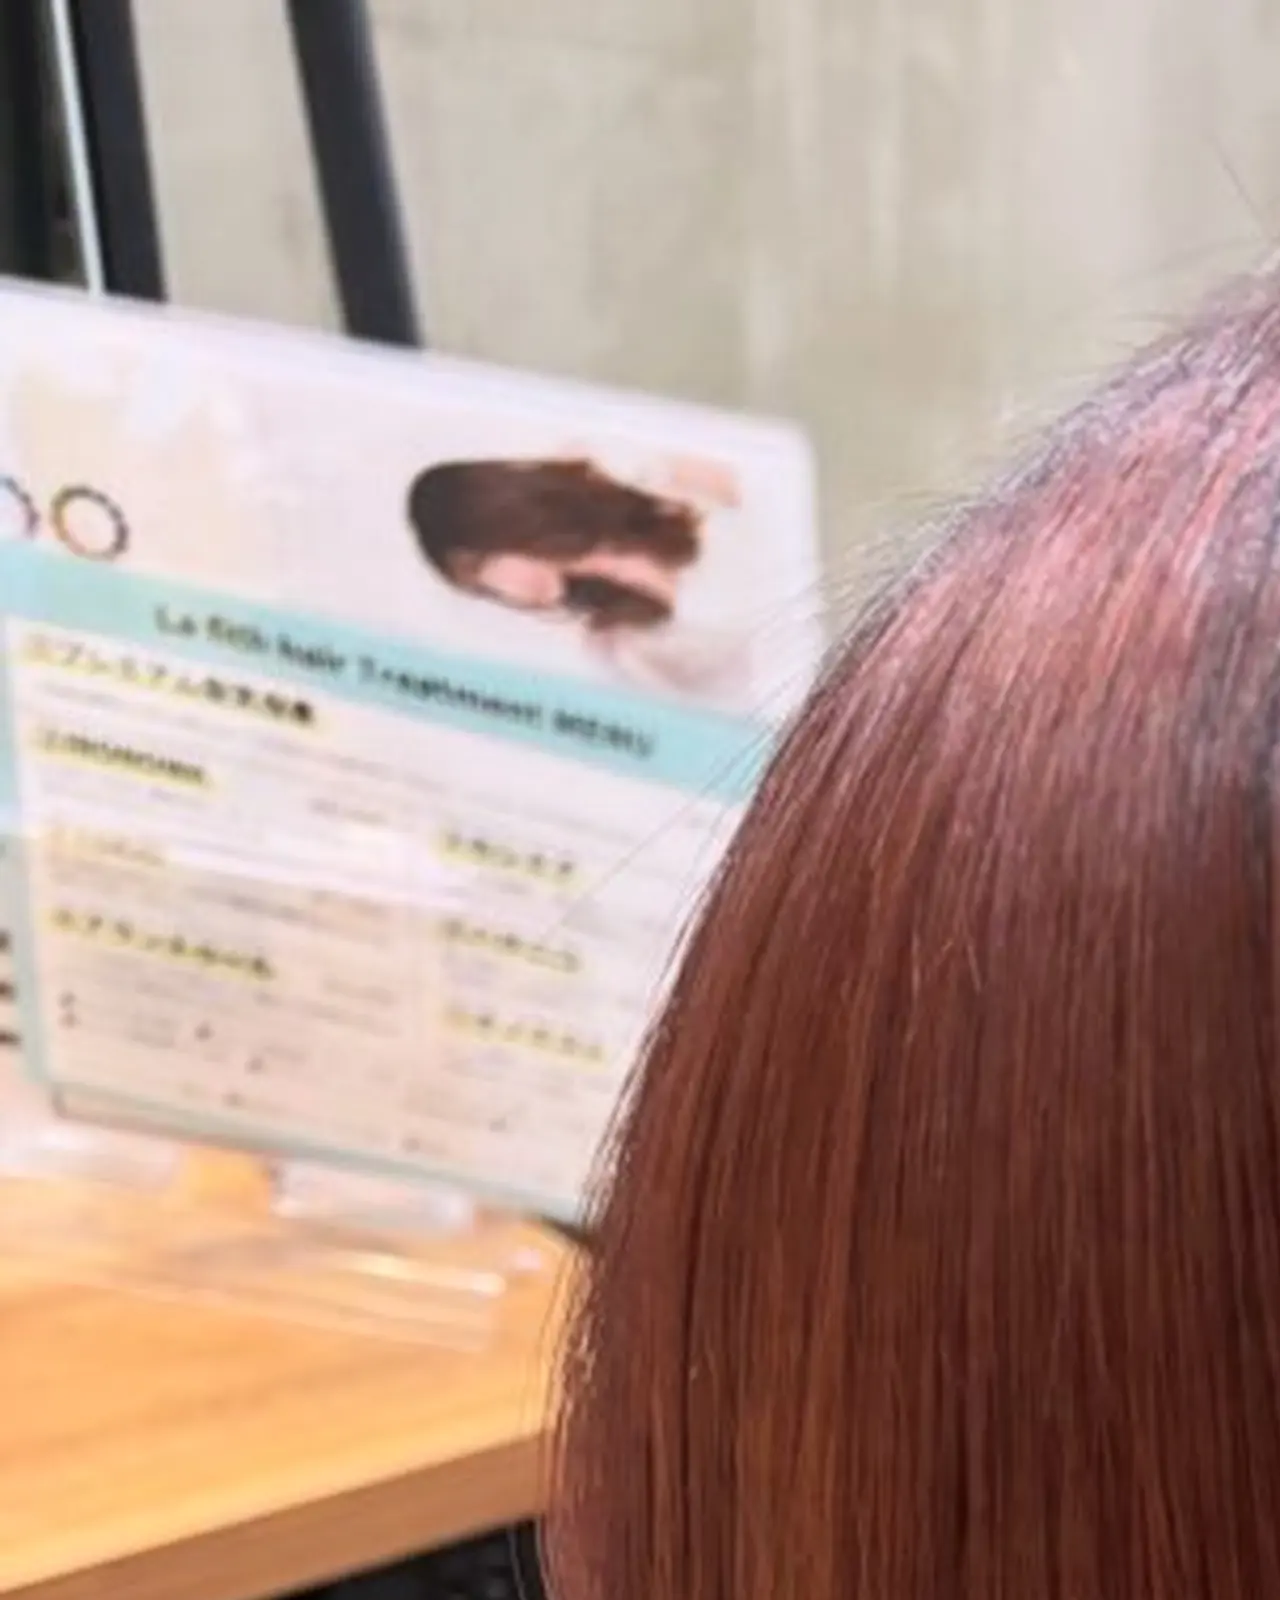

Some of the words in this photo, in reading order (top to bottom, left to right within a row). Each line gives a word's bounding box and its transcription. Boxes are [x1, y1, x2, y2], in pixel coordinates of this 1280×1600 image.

[154, 603, 197, 636] La
[277, 632, 346, 674] hair
[357, 654, 544, 731] Treatment
